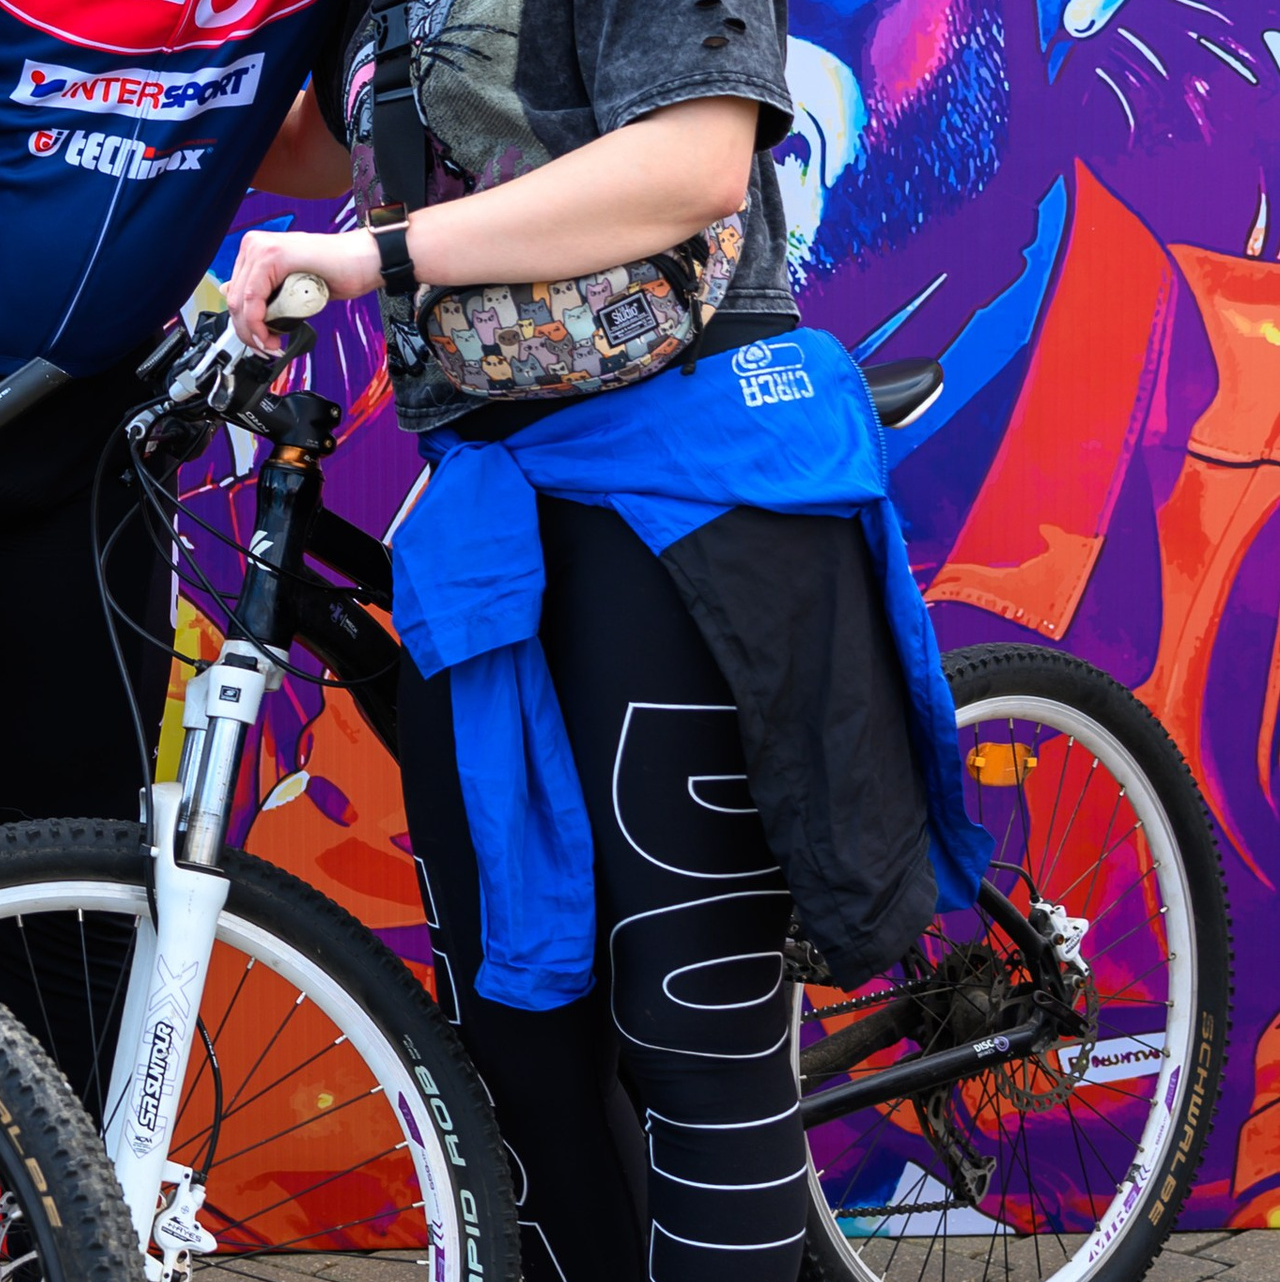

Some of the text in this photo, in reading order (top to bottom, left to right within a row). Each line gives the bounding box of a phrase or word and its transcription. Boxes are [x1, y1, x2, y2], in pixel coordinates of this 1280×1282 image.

[61, 67, 250, 110] INTERSPORT
[143, 1020, 174, 1099] SUNTOUR
[973, 1037, 996, 1054] DISC
[414, 1065, 468, 1168] ROB
[1149, 1011, 1215, 1226] SCHWALBE
